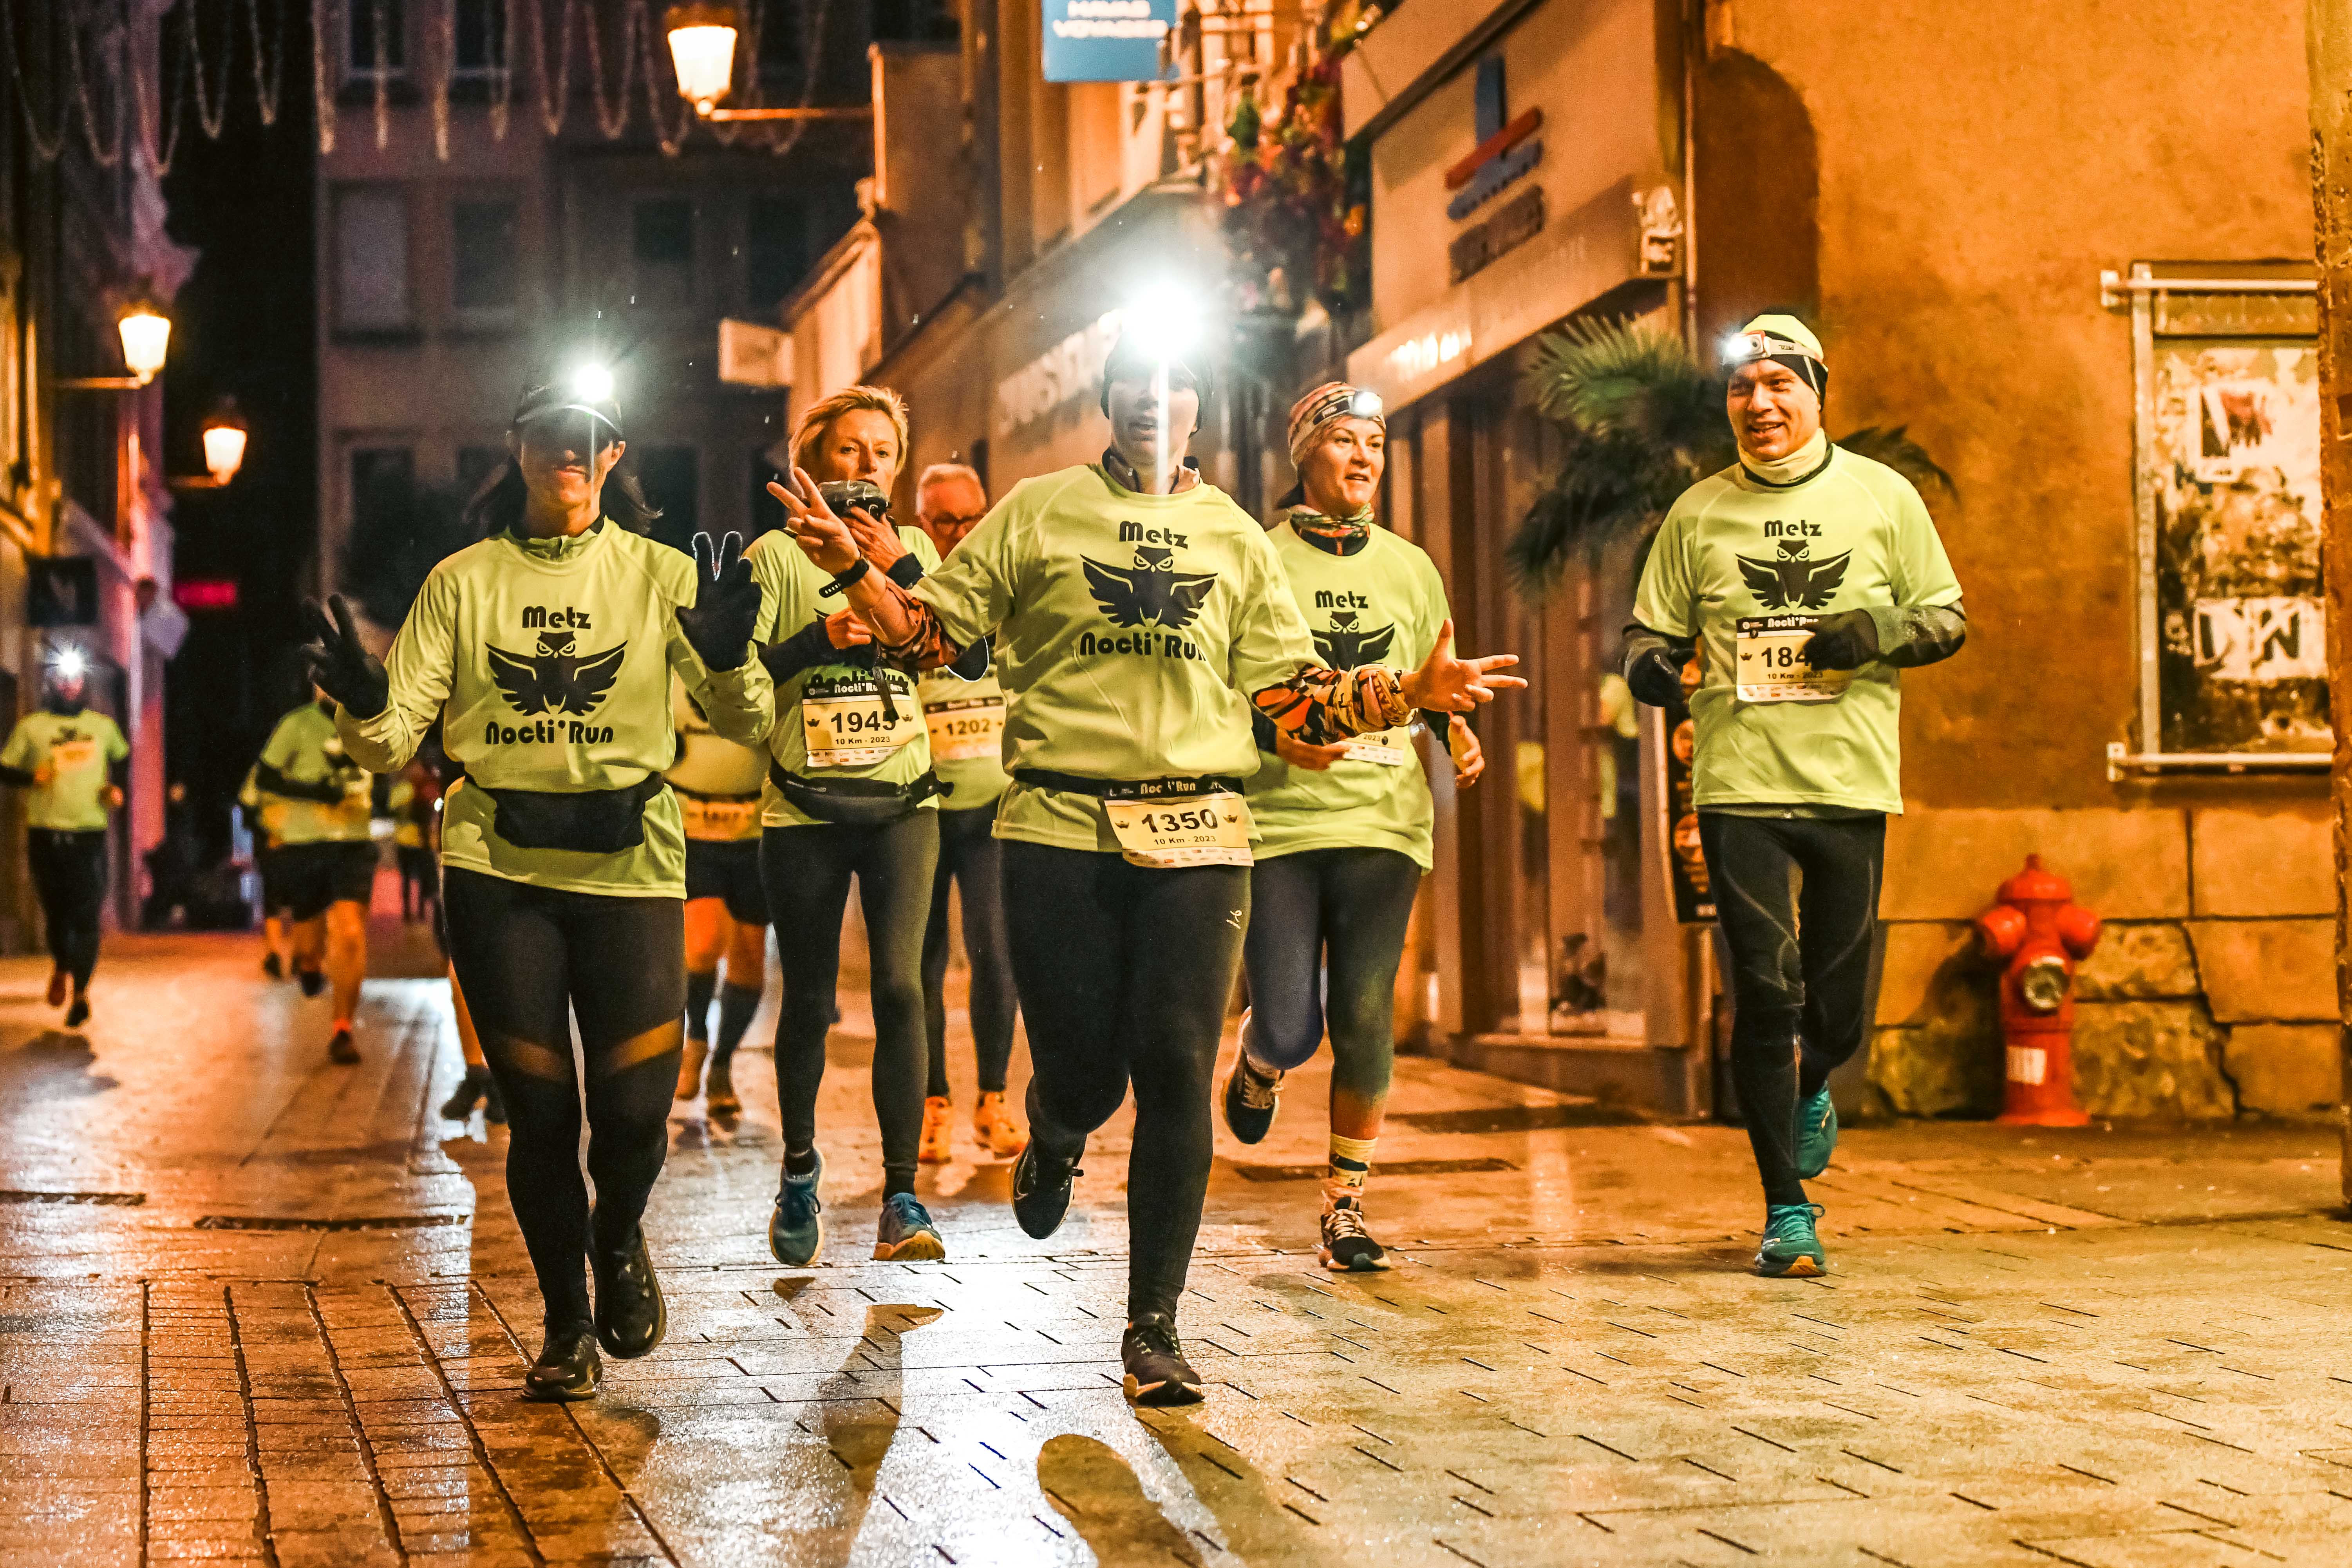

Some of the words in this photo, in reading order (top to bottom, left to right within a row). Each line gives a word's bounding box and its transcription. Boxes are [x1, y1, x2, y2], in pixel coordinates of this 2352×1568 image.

[1119, 521, 1188, 550] Metz
[1764, 520, 1822, 537] Metz
[1315, 590, 1369, 608] Metz
[522, 606, 591, 629] Metz
[1761, 647, 1809, 667] 184
[834, 683, 878, 693] Nocti'Ru
[485, 719, 614, 744] Nocti'Run
[946, 718, 990, 735] 1202
[1142, 808, 1218, 833] 1350
